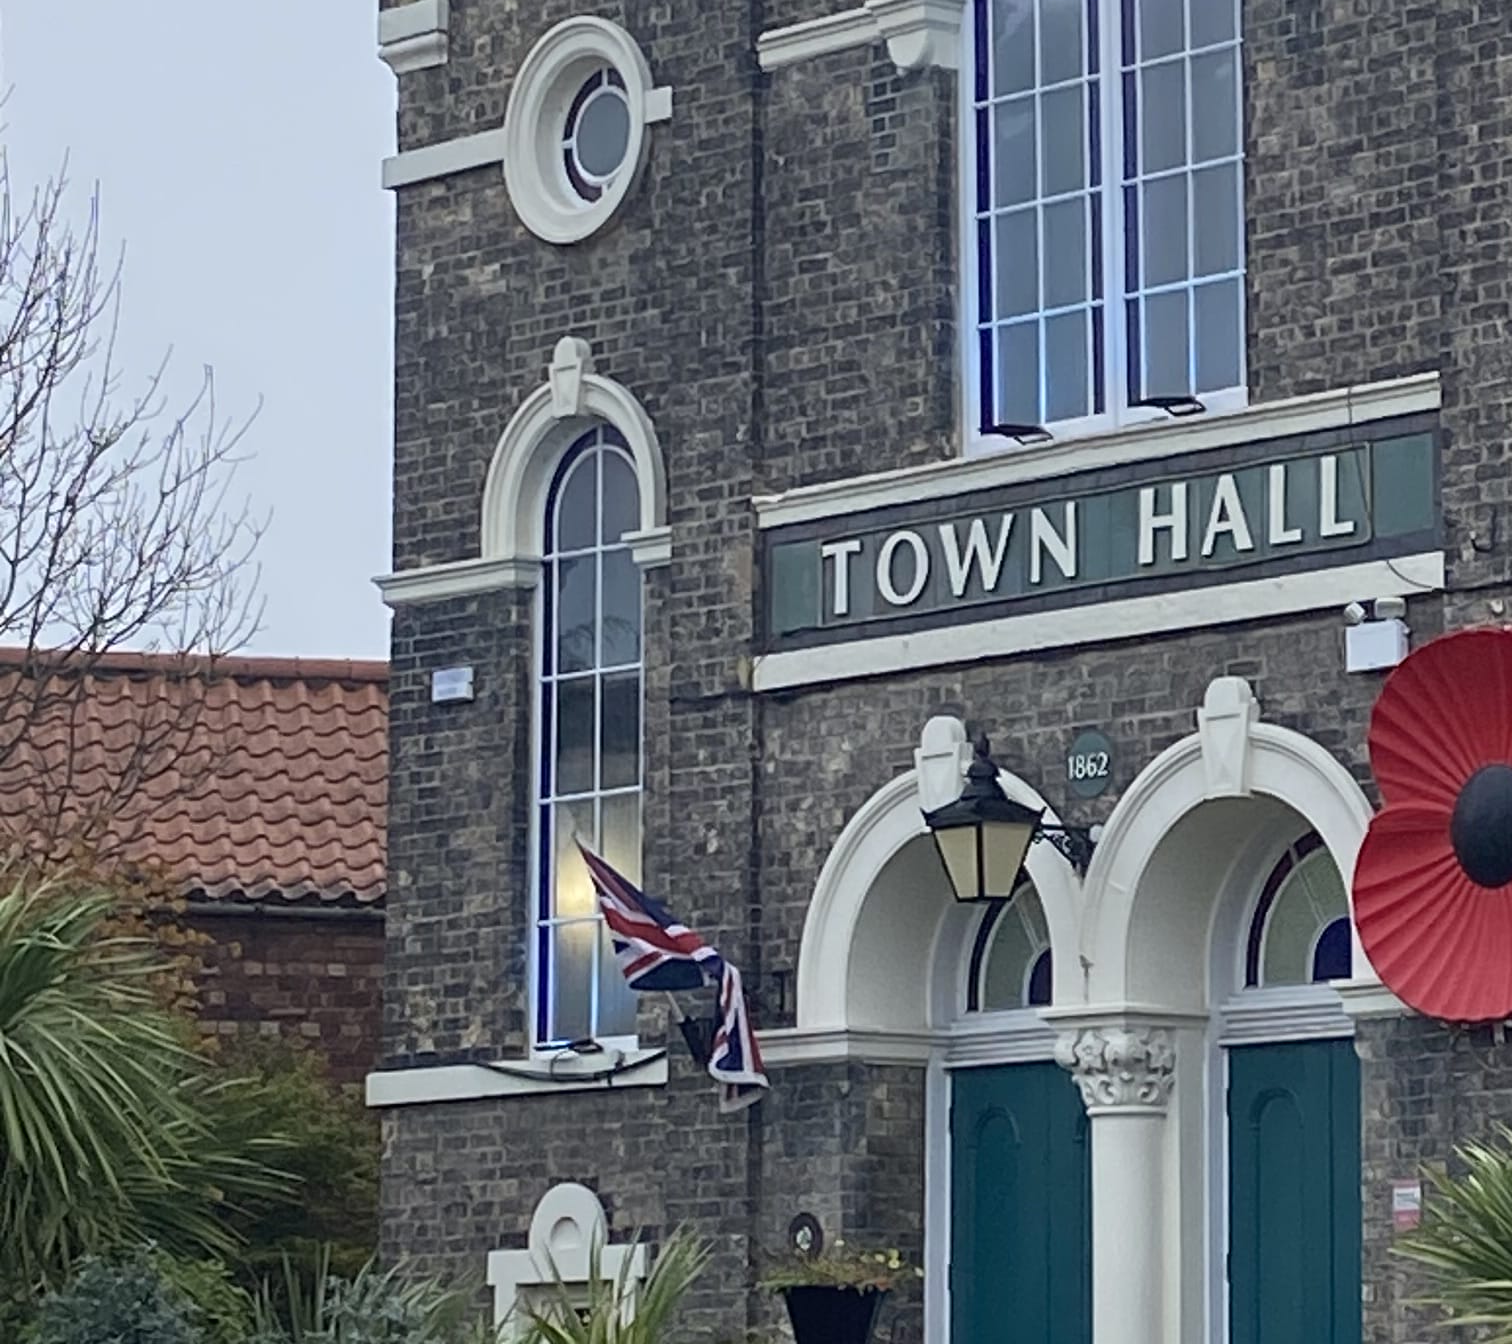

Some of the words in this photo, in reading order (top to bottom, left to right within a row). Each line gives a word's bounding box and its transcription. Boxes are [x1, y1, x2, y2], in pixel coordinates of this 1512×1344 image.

[821, 501, 1077, 615] TOWN
[1138, 455, 1355, 565] HALL
[1068, 751, 1109, 780] 1862
